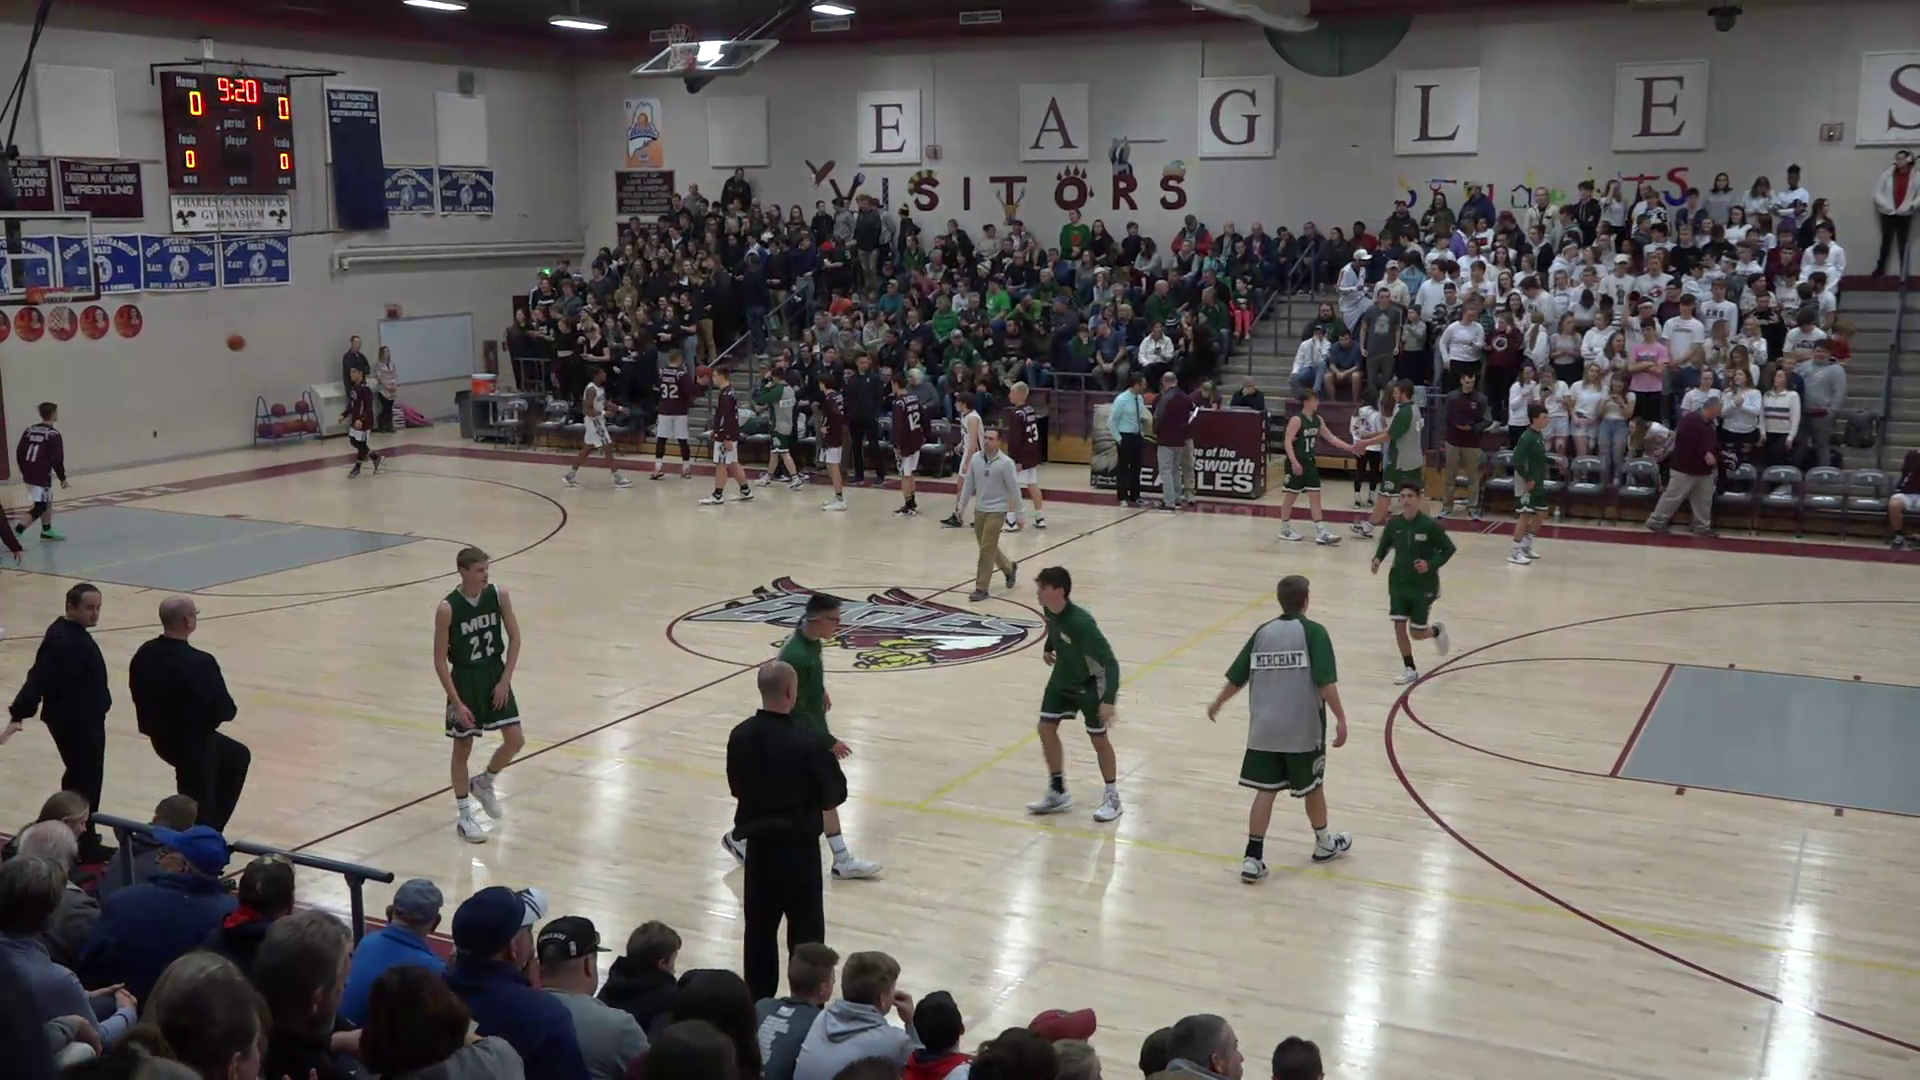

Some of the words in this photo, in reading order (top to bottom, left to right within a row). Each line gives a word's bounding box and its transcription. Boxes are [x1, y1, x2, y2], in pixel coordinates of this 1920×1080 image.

[175, 76, 197, 88] Home
[217, 77, 257, 103] 9:20
[189, 91, 202, 116] 0
[278, 97, 289, 120] 0
[223, 119, 246, 130] period
[257, 115, 261, 131] 1
[185, 150, 196, 168] 0
[280, 153, 289, 170] 0
[70, 185, 134, 195] WRESTLING
[201, 209, 265, 220] GYMNASIUM
[660, 383, 679, 399] 32
[908, 411, 921, 431] 12
[26, 443, 39, 462] 11
[1206, 448, 1217, 457] of
[1219, 448, 1237, 458] the
[1194, 457, 1255, 474] sworth
[461, 612, 497, 636] MDI
[469, 630, 495, 661] 22
[1256, 652, 1303, 667] MERCHANT
